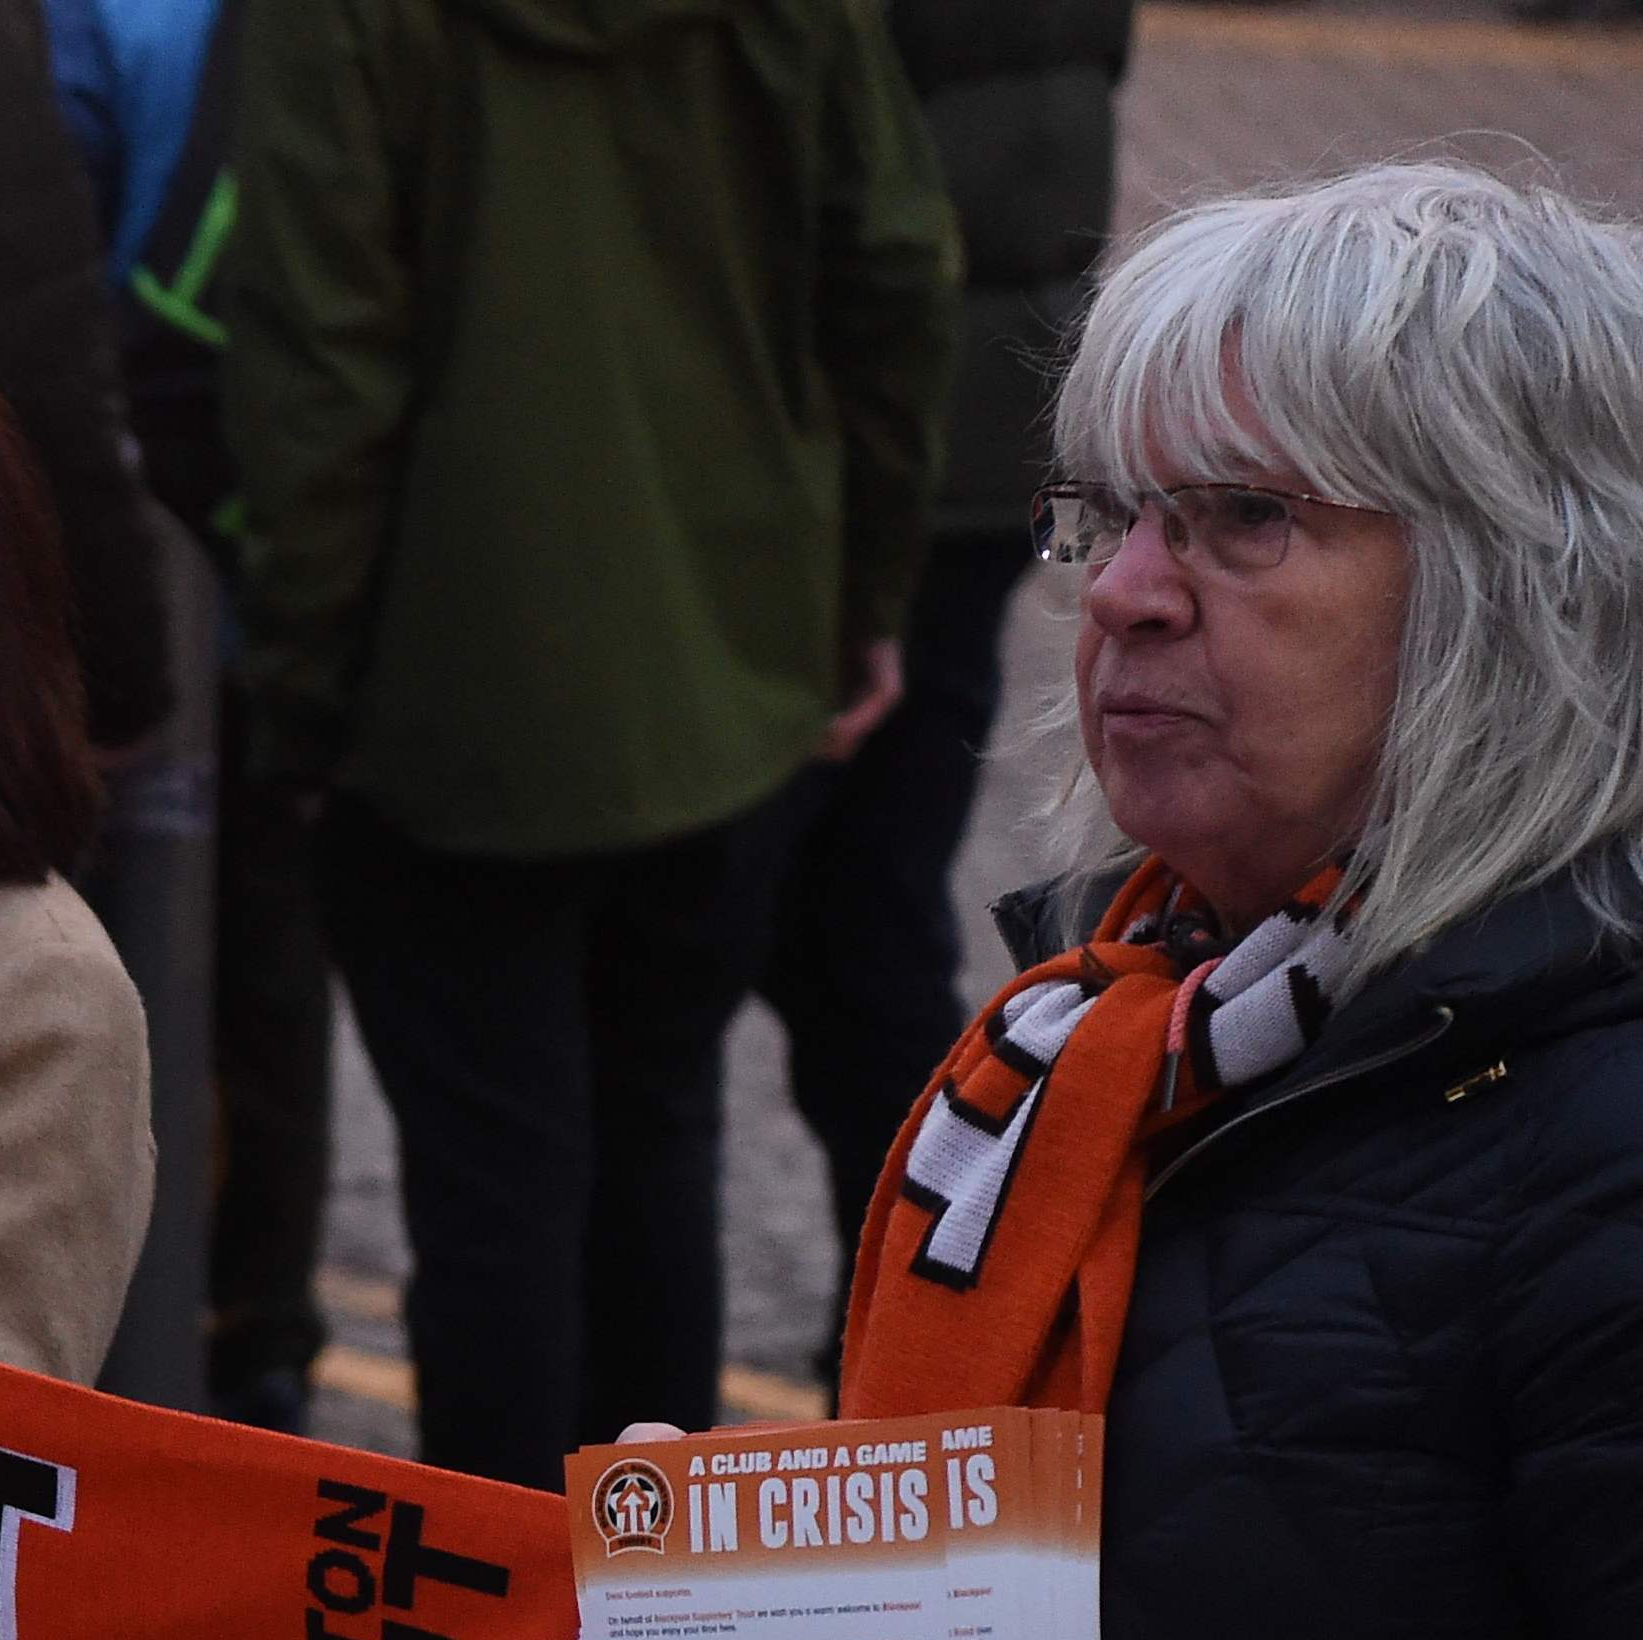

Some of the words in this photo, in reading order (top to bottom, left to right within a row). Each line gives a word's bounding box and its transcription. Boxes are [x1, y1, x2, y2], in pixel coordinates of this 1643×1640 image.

[689, 1456, 705, 1477] A
[711, 1451, 772, 1475] CLUB
[777, 1447, 828, 1470] AND
[833, 1446, 850, 1467] A
[856, 1440, 926, 1466] GAME
[689, 1482, 738, 1553] IN
[758, 1468, 929, 1549] CRISIS
